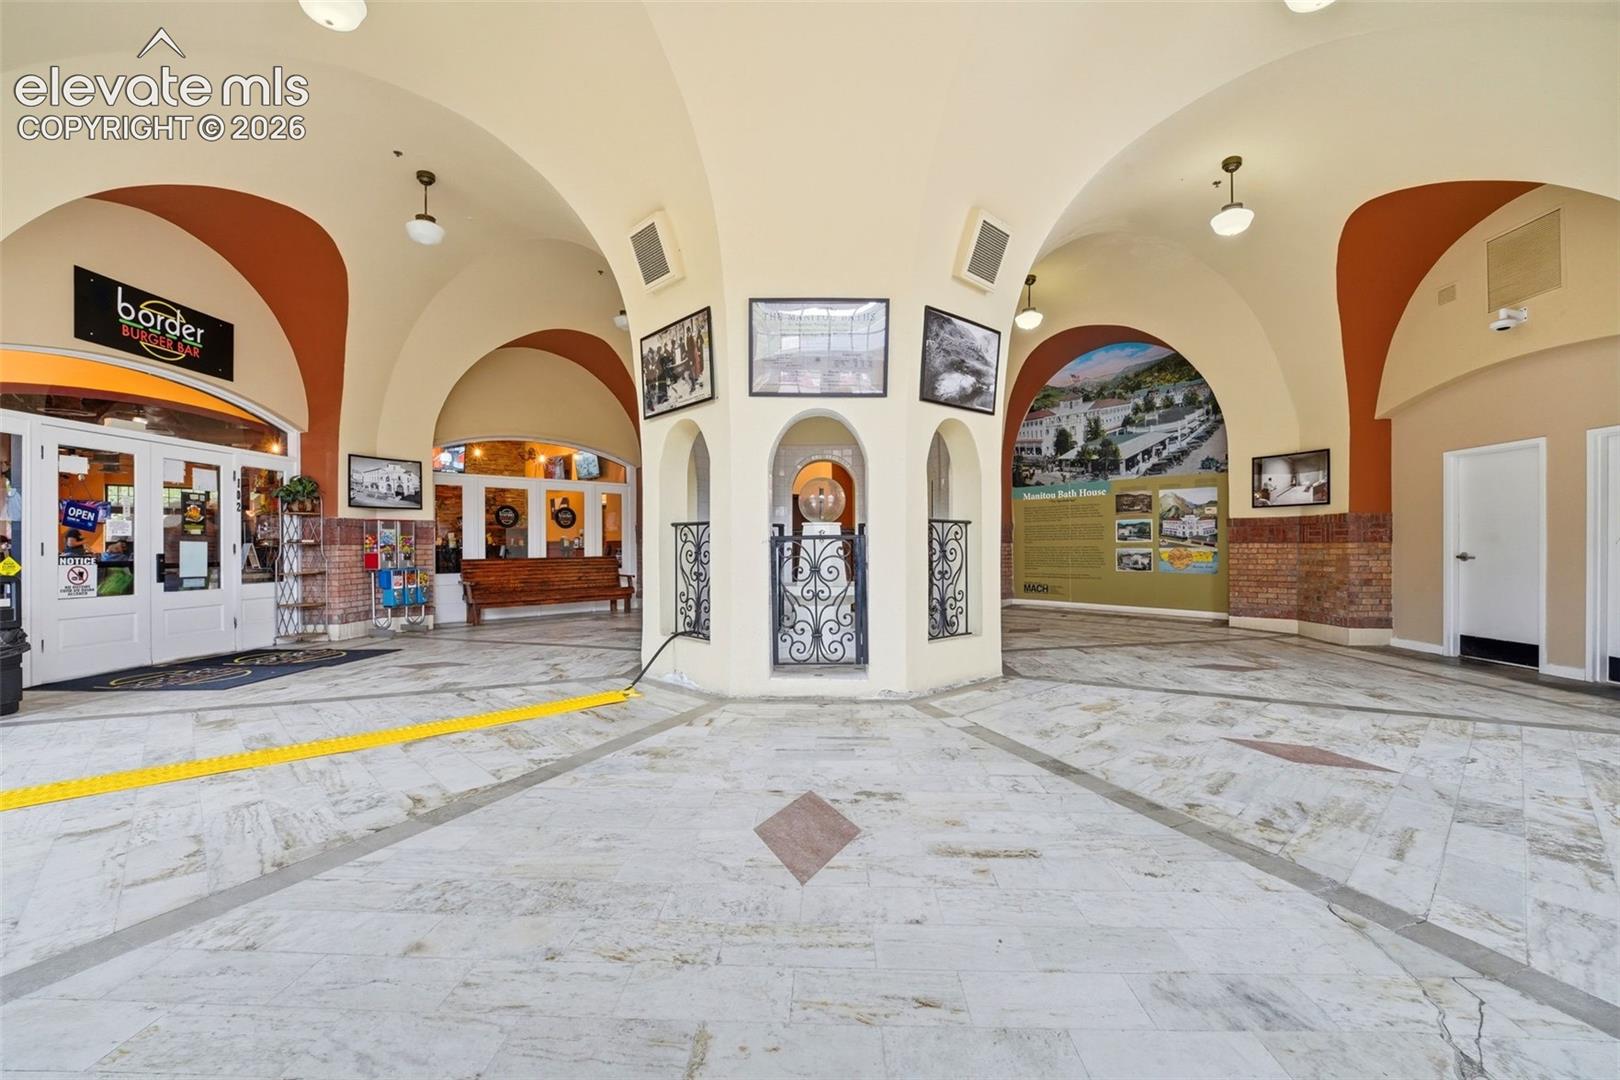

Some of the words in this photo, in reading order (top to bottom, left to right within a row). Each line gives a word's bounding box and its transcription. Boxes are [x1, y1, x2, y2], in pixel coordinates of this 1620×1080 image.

[117, 286, 204, 343] border
[122, 324, 174, 351] BURGER
[177, 341, 201, 359] BAR
[1023, 491, 1056, 500] Manitou
[1057, 489, 1077, 499] Bath
[1079, 488, 1107, 497] House
[68, 506, 96, 522] OPEN
[59, 557, 97, 566] NOTICE
[1024, 584, 1048, 593] MACH
